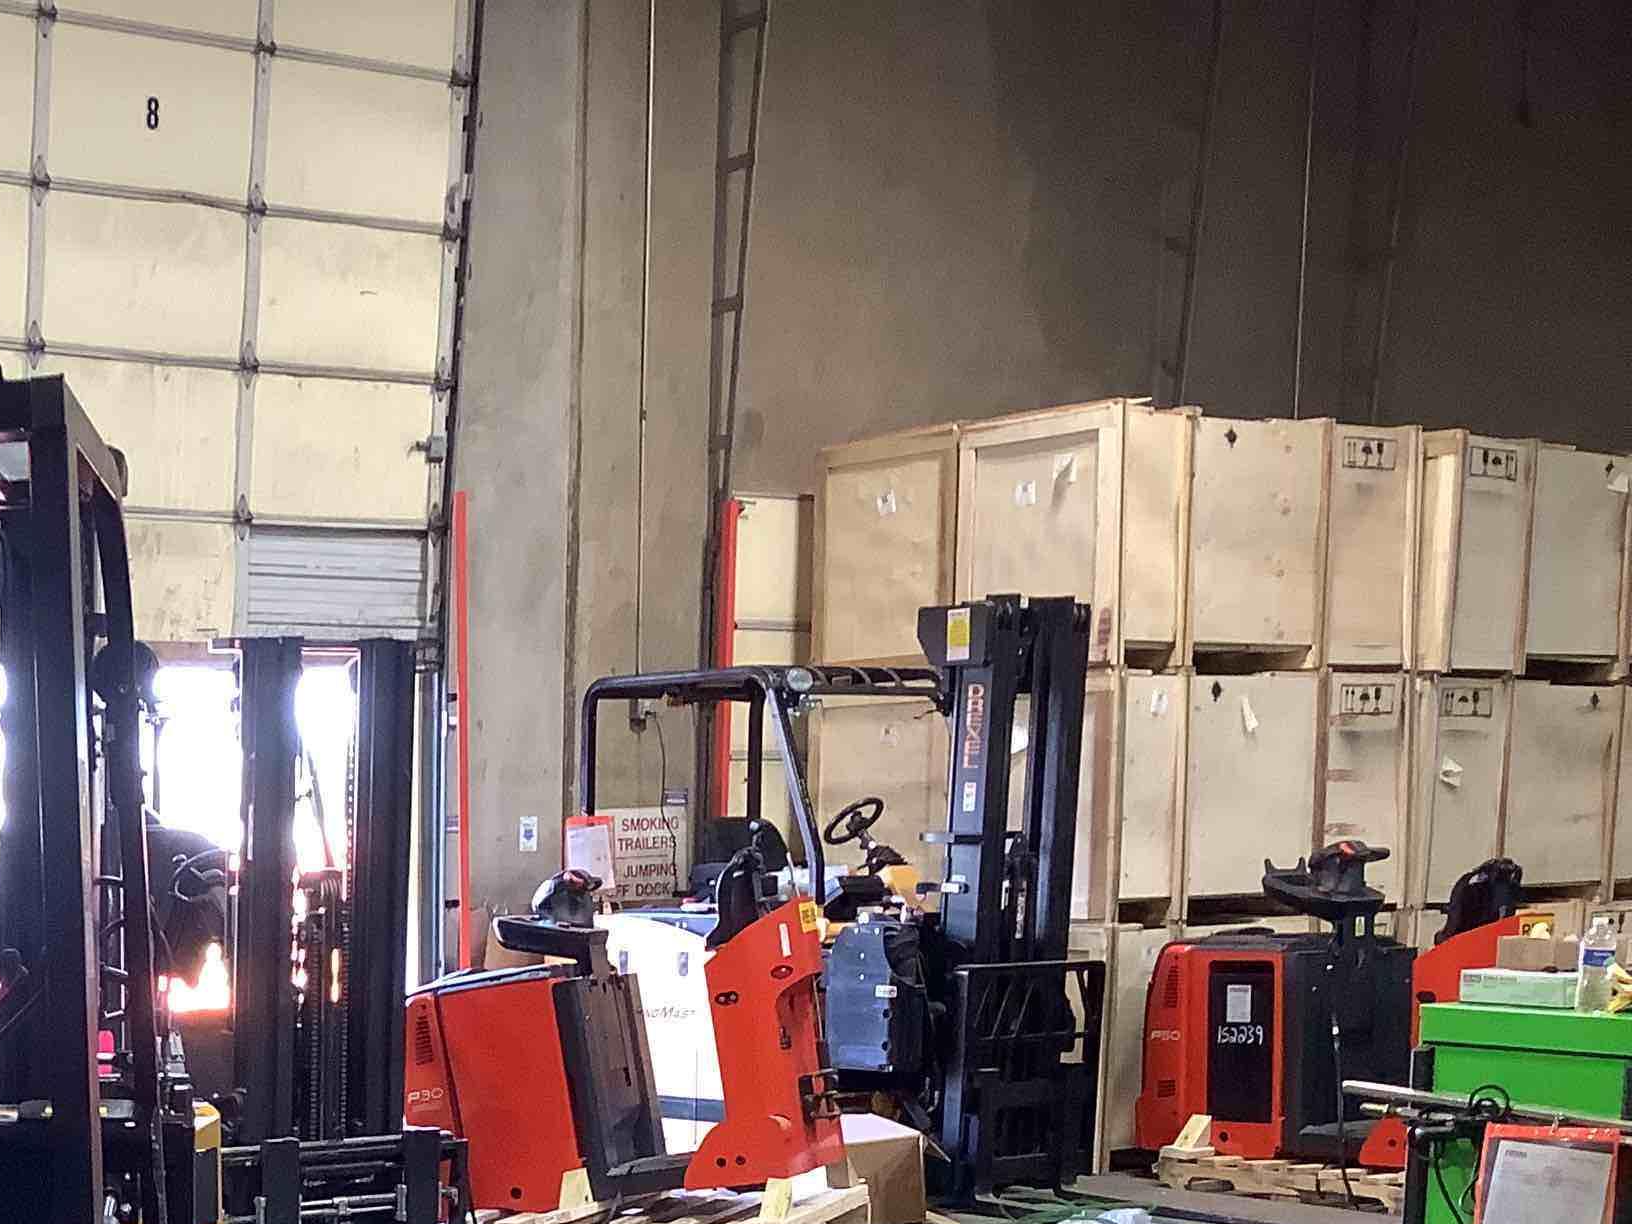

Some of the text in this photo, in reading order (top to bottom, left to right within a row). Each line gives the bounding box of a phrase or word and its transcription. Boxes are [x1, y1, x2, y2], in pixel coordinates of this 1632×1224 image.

[147, 97, 159, 130] 8
[621, 815, 679, 832] SMOKING
[617, 835, 676, 851] TRAILERS
[623, 862, 677, 879] JUMPING
[635, 882, 672, 897] DOCK
[1216, 1024, 1264, 1046] 152239
